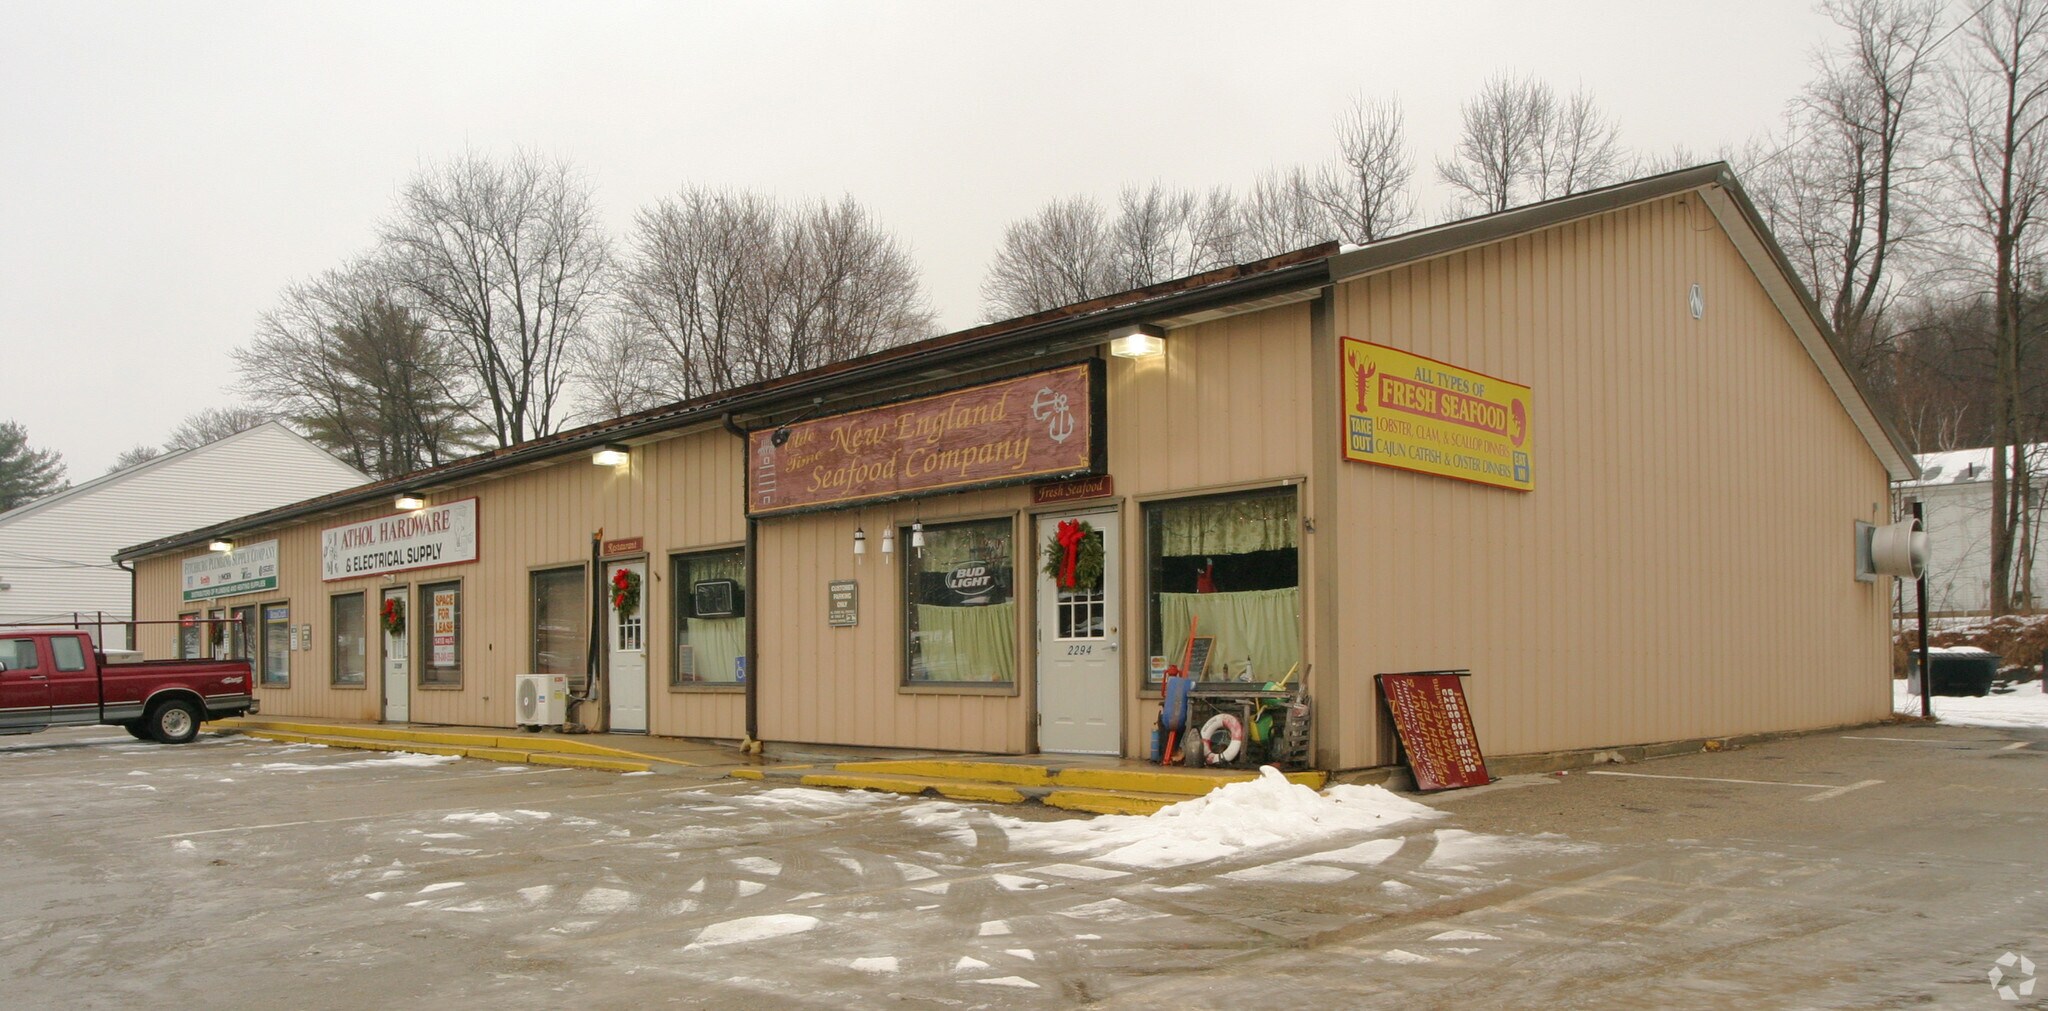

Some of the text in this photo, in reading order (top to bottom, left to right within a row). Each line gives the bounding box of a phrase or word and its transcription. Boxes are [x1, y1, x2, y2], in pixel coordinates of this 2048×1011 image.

[1415, 367, 1485, 397] ALL TYPES OF
[1382, 378, 1505, 430] FRESH SEAFOOD
[831, 391, 1008, 454] New England
[1351, 417, 1372, 434] TAKE
[1376, 416, 1413, 438] LOBSTER,
[1443, 432, 1450, 444] &
[1451, 432, 1483, 450] SCALLOP
[1483, 439, 1510, 457] DINNERS
[1352, 435, 1371, 451] OUT
[785, 449, 824, 473] Time
[807, 437, 1030, 494] Seafood Company
[1376, 439, 1511, 478] CAJUN CATFISH & OYSTER DINNERS
[1514, 454, 1527, 466] EAT
[1038, 480, 1103, 501] Fresh Seafood
[340, 510, 451, 550] ATHOL HARDWARE
[346, 543, 442, 572] & ELECTRICAL SUPPLY
[950, 576, 991, 589] LIGHT
[956, 567, 986, 578] BUD
[436, 594, 453, 606] SPACE
[438, 608, 449, 620] FOR
[435, 622, 453, 633] LEASE
[1068, 645, 1092, 656] 2294
[1393, 680, 1411, 730] England
[1402, 680, 1420, 733] Company
[1412, 693, 1446, 785] RESTAURANT
[1418, 689, 1449, 773] FRESH FISH
[1430, 702, 1454, 761] MARKET
